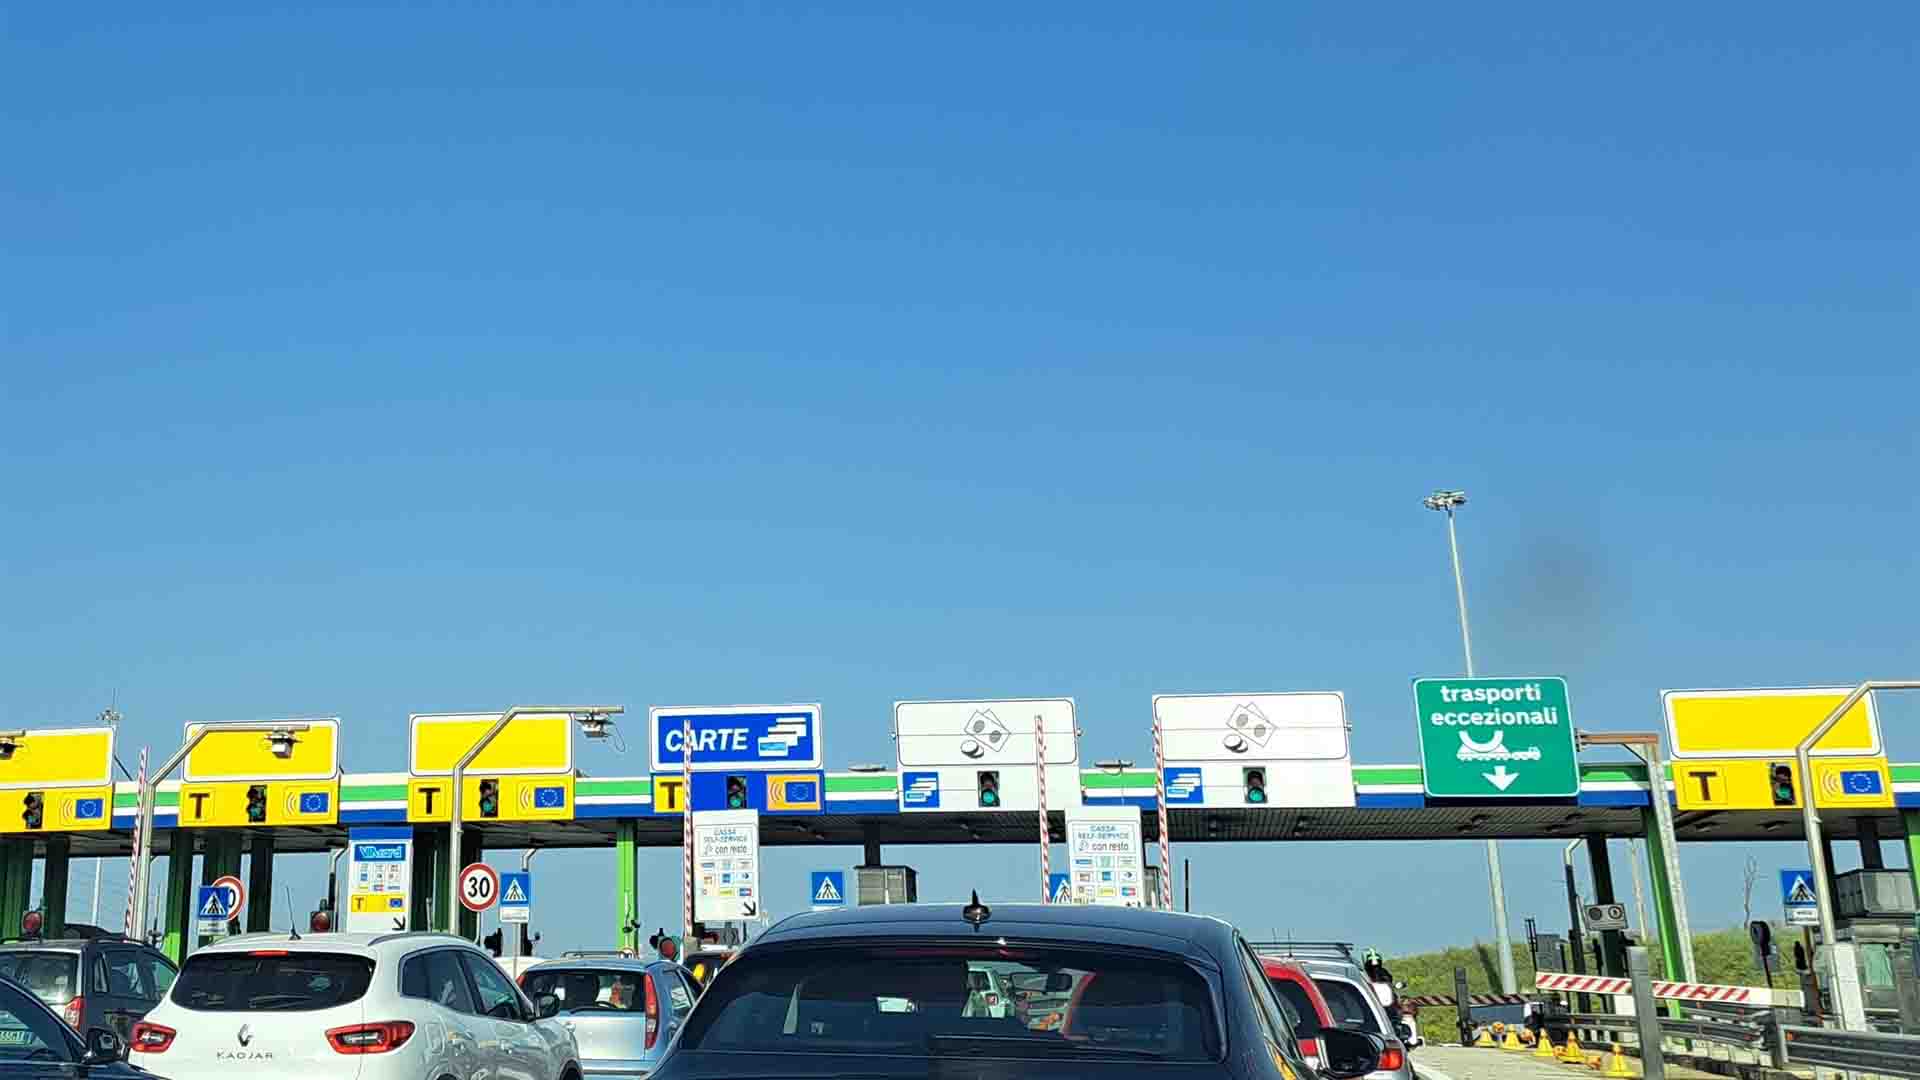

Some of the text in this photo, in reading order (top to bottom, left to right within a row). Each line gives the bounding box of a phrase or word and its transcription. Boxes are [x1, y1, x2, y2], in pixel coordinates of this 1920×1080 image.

[1440, 684, 1542, 704] trasporti
[1431, 707, 1558, 725] eccezionali
[665, 728, 749, 751] CARTE
[659, 781, 684, 808] T
[1688, 771, 1717, 801] T
[189, 793, 210, 819] T
[419, 787, 441, 814] T
[1092, 841, 1129, 851] con resto
[468, 876, 490, 898] 30
